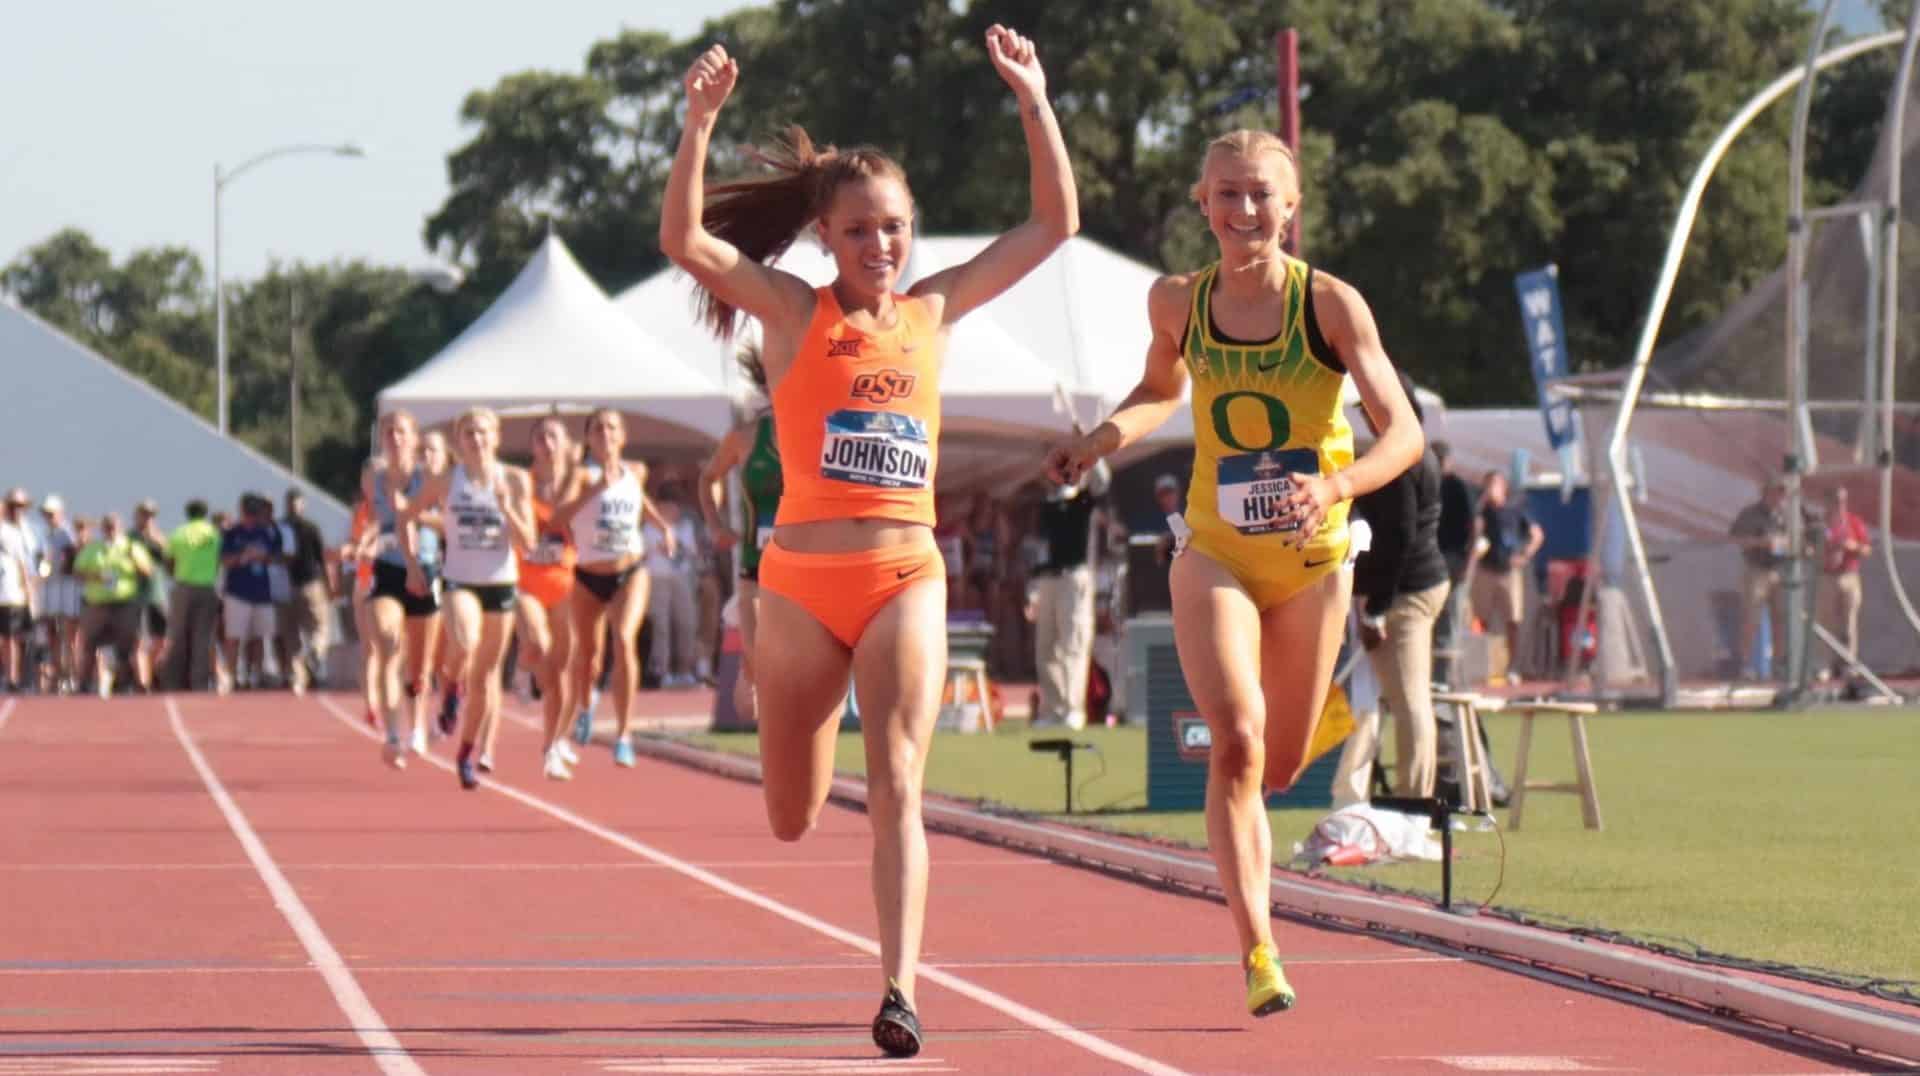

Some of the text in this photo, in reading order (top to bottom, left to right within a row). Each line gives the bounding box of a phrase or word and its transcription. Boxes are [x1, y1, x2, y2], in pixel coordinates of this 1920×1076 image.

[850, 369, 916, 403] OSU
[1211, 391, 1291, 452] O
[823, 437, 927, 480] JOHNSON
[1248, 480, 1291, 495] JESSICA
